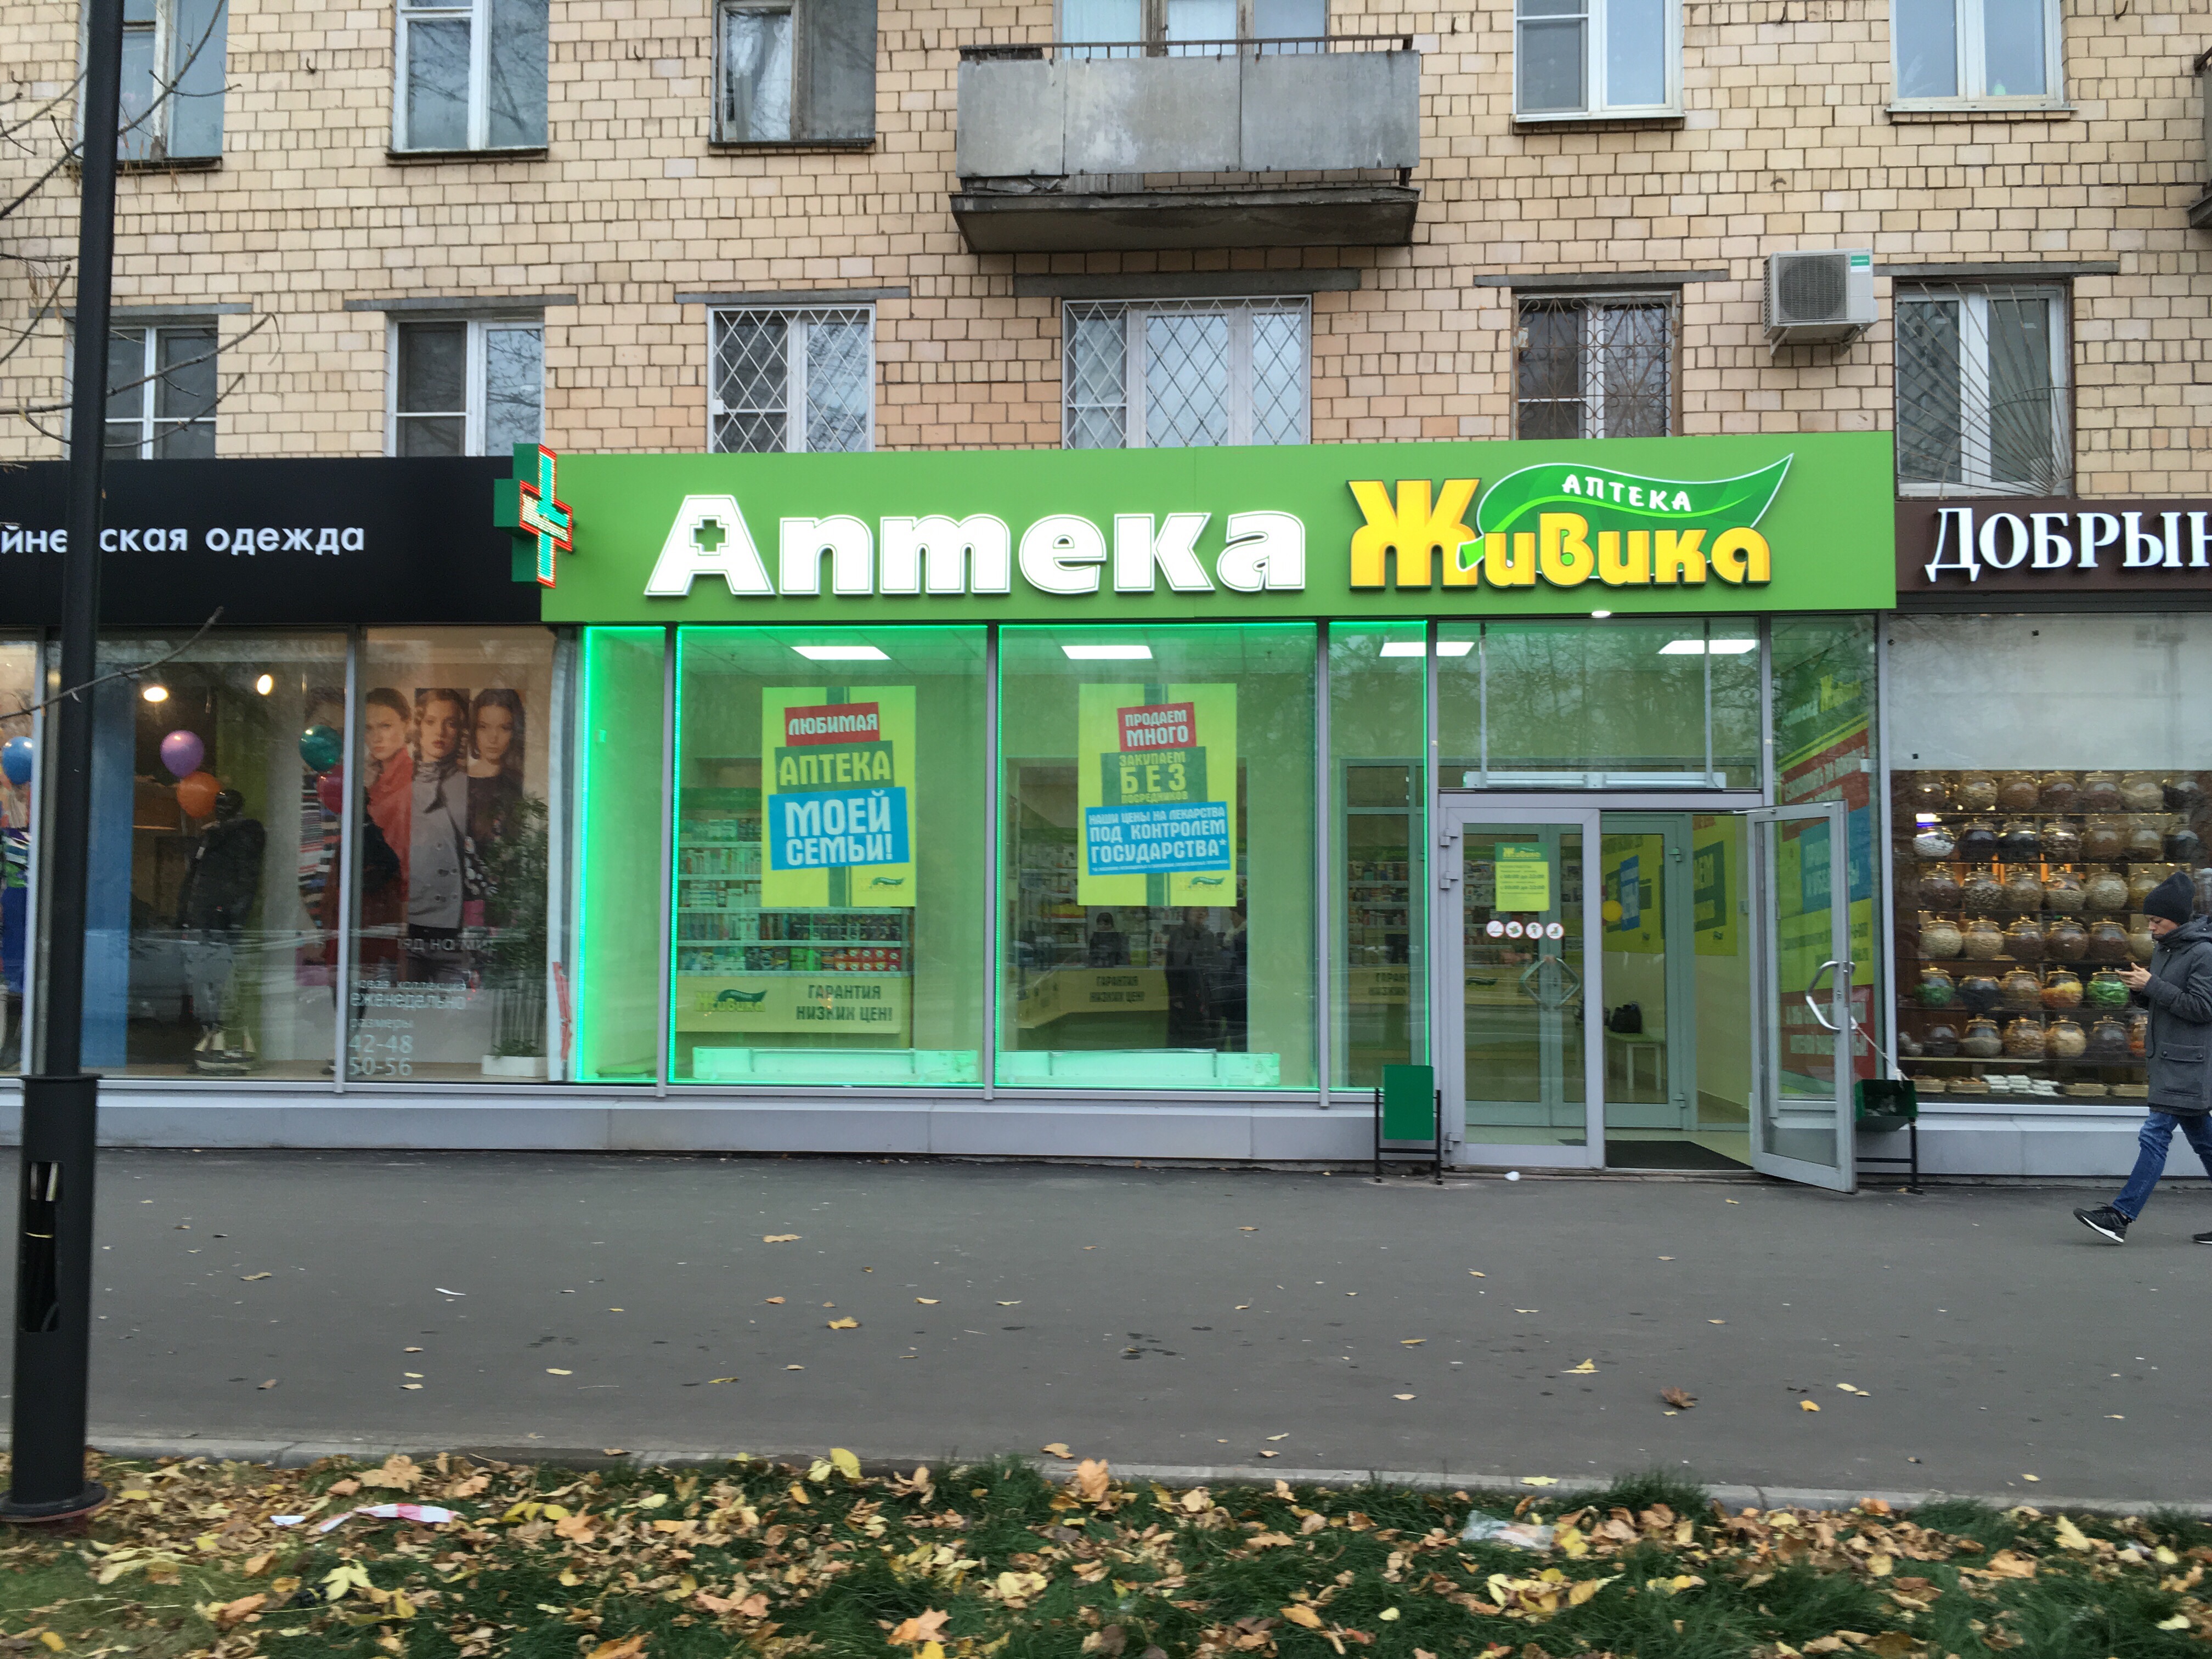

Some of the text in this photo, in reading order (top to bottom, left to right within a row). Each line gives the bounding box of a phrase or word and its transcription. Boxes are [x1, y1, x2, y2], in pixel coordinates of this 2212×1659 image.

[1561, 473, 1692, 512] АПТЕКА
[1, 524, 364, 556] йнеская одежда
[1346, 478, 1771, 589] Живика
[644, 494, 1307, 597] Аптека
[788, 713, 878, 736] ЛЮБИМАЯ
[1125, 709, 1187, 727] ПРОДАЕМ
[1126, 725, 1189, 747] МНОГО
[780, 750, 891, 786] АПТЕКА
[1119, 751, 1186, 767] ЗАКУПАЕМ
[1120, 763, 1187, 794] БЕЗ
[785, 789, 891, 838] МОЕЙ
[1121, 811, 1150, 824] ЦЕНЫ
[1153, 810, 1167, 821] НА
[1169, 806, 1225, 820] ЛЕКАРСТВА
[1090, 819, 1226, 843] ПОД КОНТРОЛЕМ
[786, 833, 893, 866] СЕМЬИ!
[808, 984, 882, 1000] ГАРАНТИЯ
[860, 1006, 893, 1023] ЦЕН!
[348, 1034, 413, 1053] 42-48
[348, 1057, 413, 1076] 50-56
